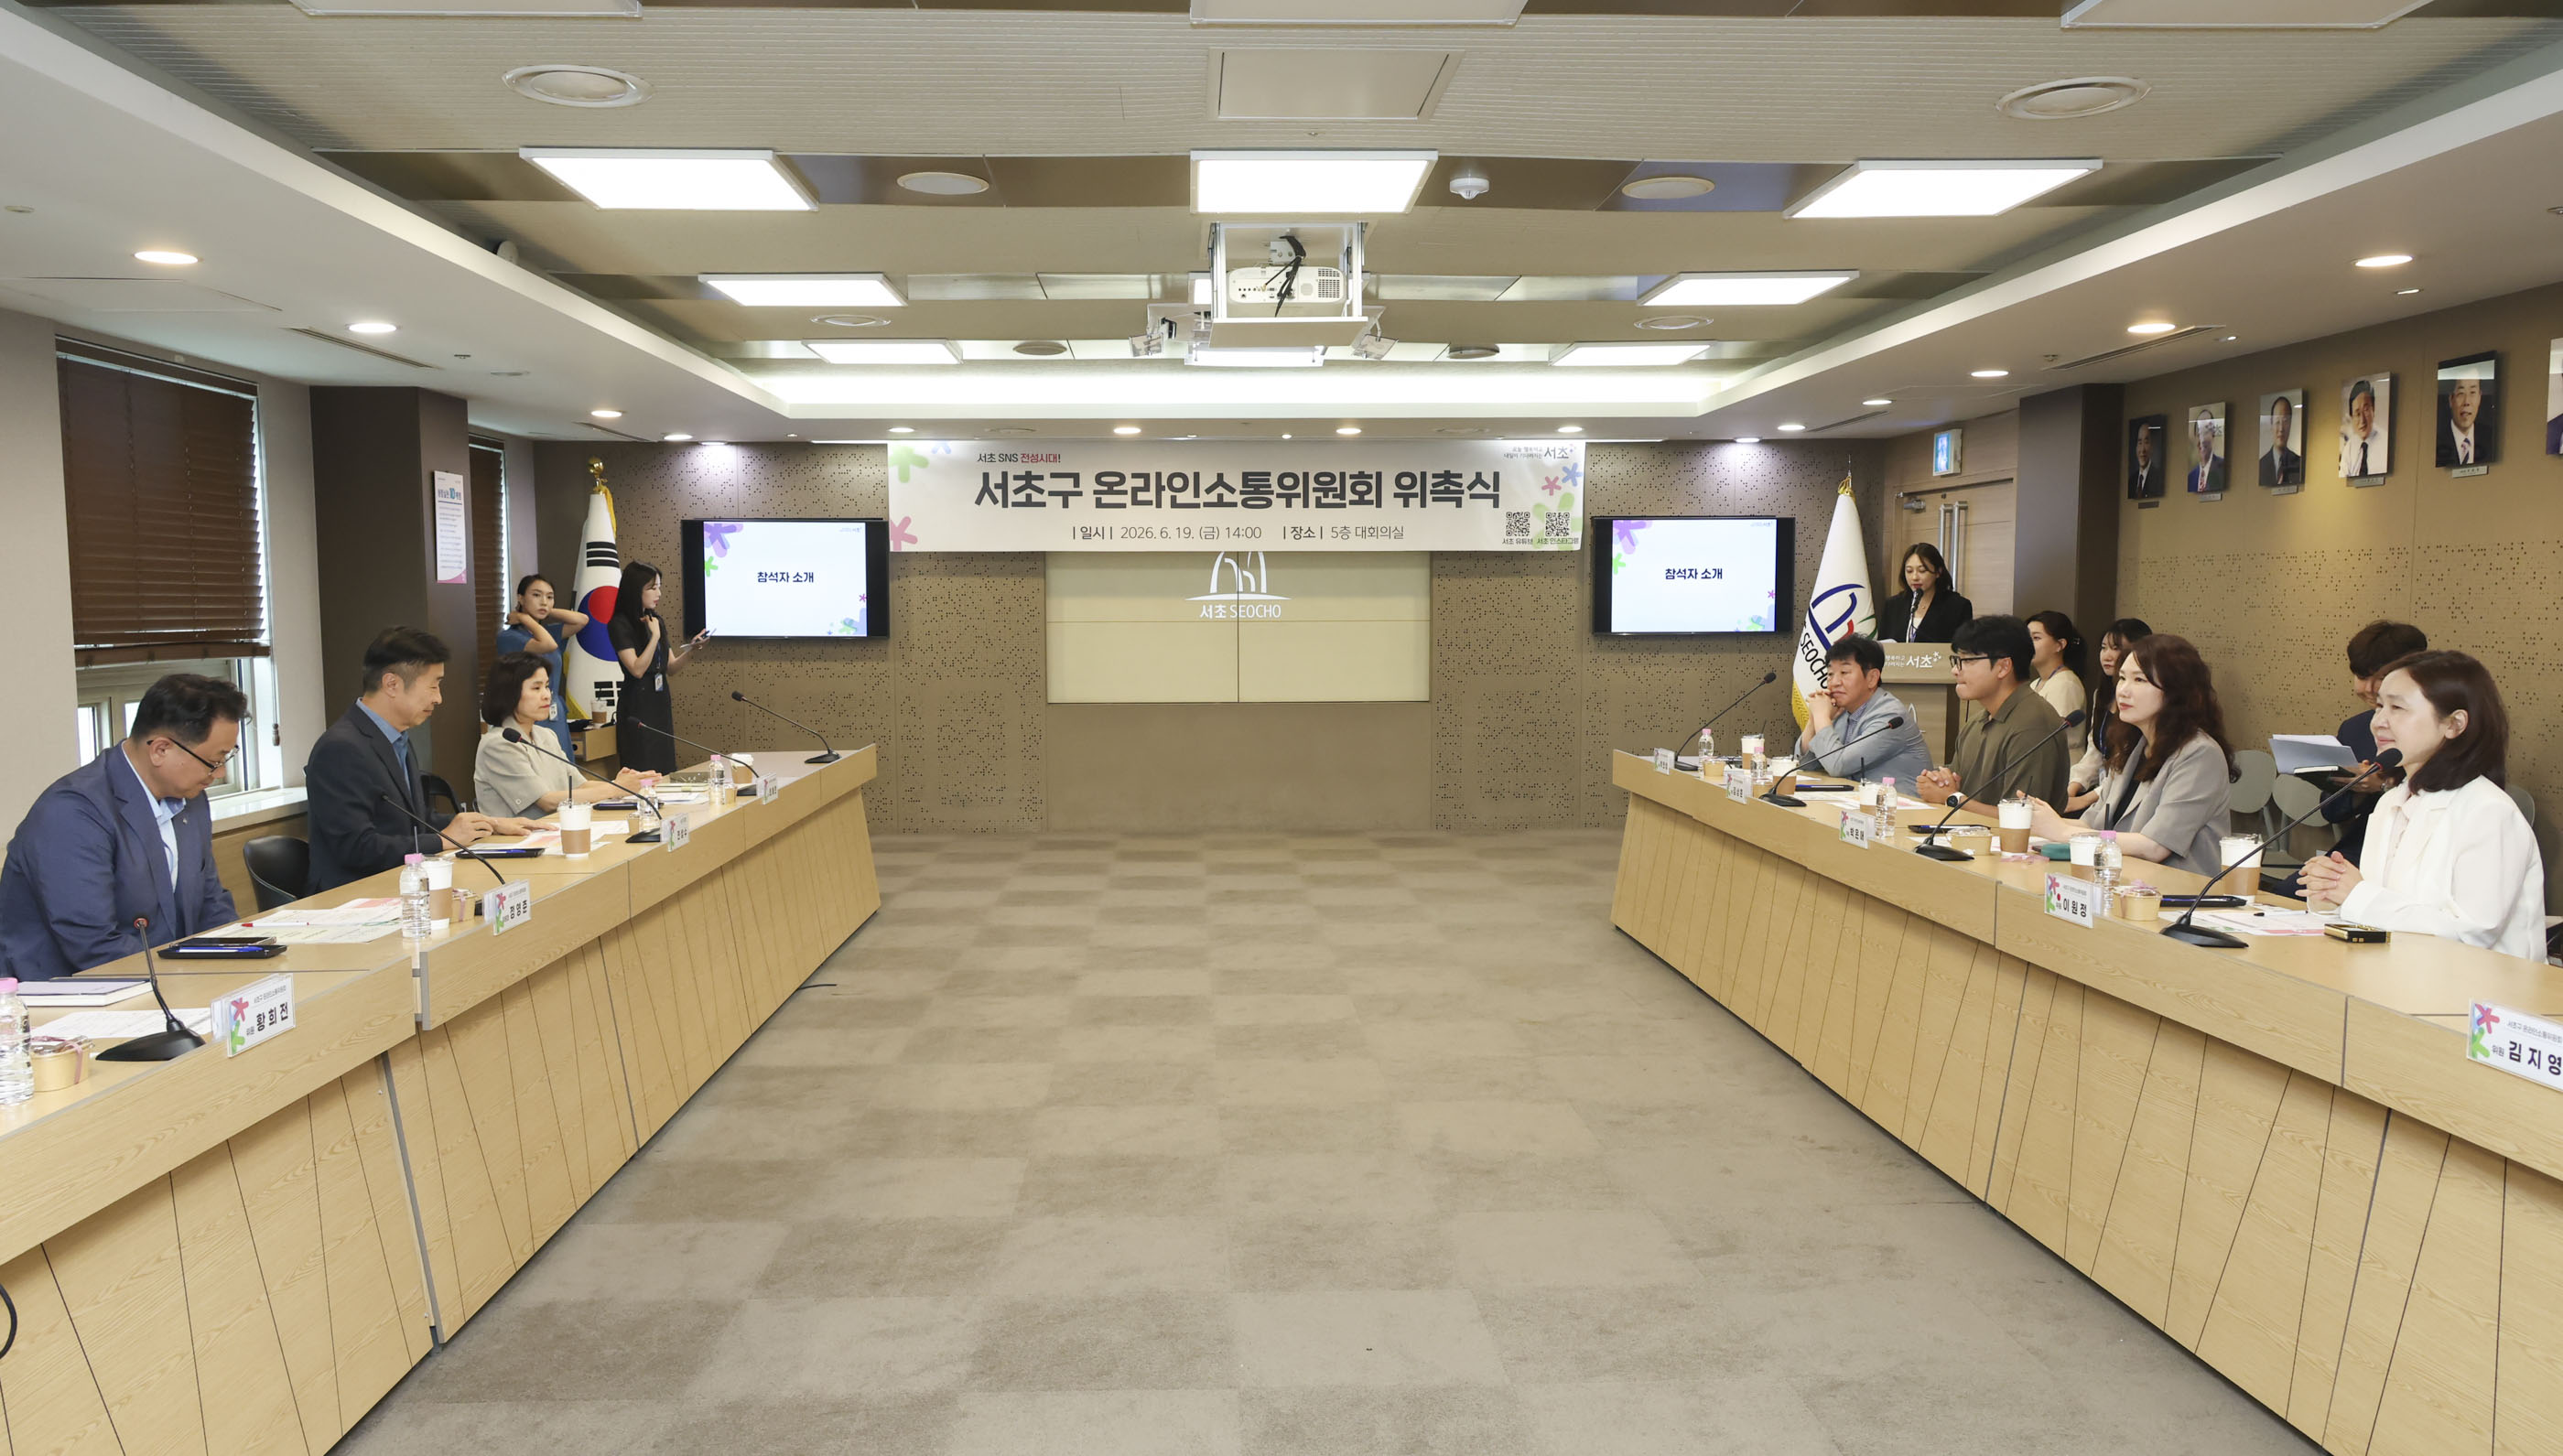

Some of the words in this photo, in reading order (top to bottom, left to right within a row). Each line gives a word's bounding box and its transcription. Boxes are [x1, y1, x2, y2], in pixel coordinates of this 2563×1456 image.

[977, 453, 997, 463] 서초
[998, 453, 1019, 463] SNS
[1020, 453, 1061, 464] 전성시대!
[1544, 447, 1569, 459] 서초
[975, 470, 1083, 509] 서초구
[1093, 470, 1382, 509] 온라인소통위원회
[1393, 469, 1500, 509] 위촉식
[1080, 526, 1105, 540] 일시
[1198, 525, 1220, 541] (금)
[1225, 526, 1262, 540] 14:00
[1290, 525, 1316, 540] 장소
[1330, 525, 1351, 540] 5층
[1355, 525, 1405, 540] 대회의실
[757, 571, 790, 583] 참석자
[793, 571, 815, 583] 소개
[1665, 568, 1698, 580] 참석자
[1701, 568, 1723, 580] 소개
[1200, 604, 1227, 620] 서초
[1229, 604, 1282, 619] SEOCHO
[1906, 654, 1933, 668] 서초
[256, 1001, 288, 1032] 황희전
[2509, 1041, 2562, 1076] 김지영
